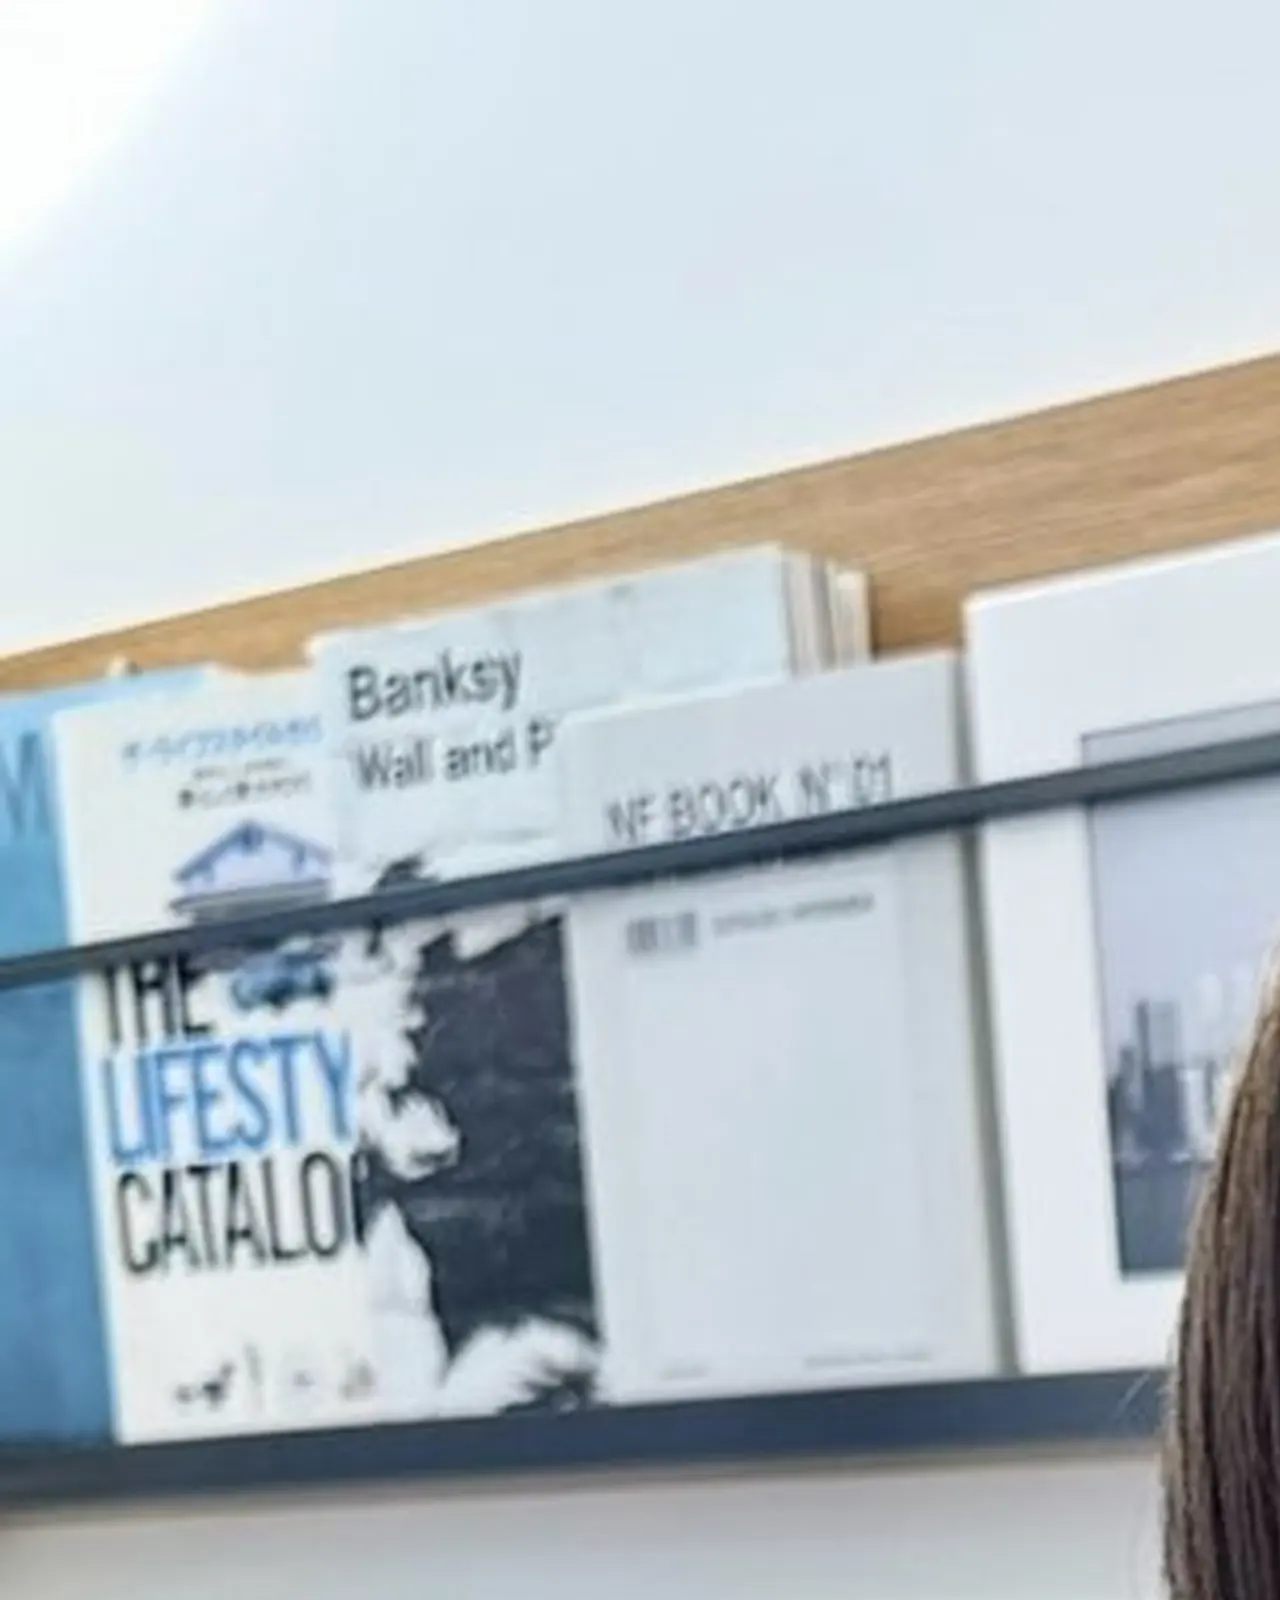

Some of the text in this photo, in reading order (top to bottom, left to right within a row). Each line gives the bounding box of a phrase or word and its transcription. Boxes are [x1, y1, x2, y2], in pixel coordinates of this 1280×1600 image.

[347, 647, 522, 720] Banksy
[356, 738, 431, 791] Wall
[444, 726, 518, 770] and
[668, 772, 783, 839] BOOK
[100, 950, 212, 1042] THE
[102, 1033, 352, 1166] LIFESTY
